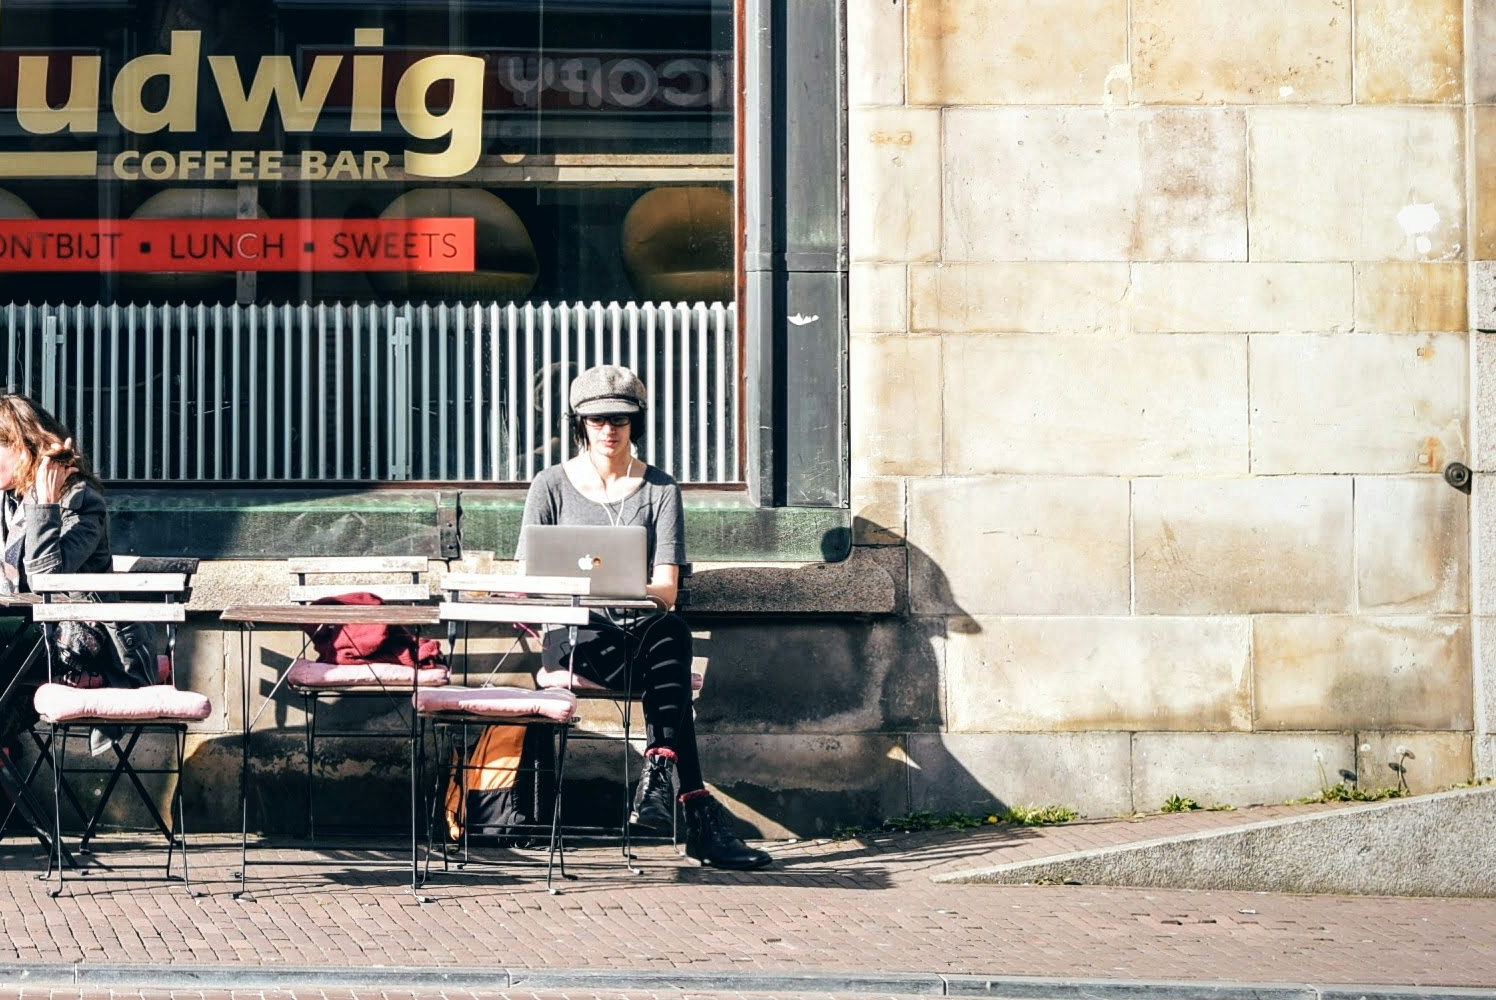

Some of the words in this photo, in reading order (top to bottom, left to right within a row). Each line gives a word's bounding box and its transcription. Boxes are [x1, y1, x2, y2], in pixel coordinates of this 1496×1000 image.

[112, 150, 285, 181] COFFEE
[301, 150, 391, 181] BAR
[169, 231, 285, 260] LUNCH
[332, 231, 458, 260] SWEETS
